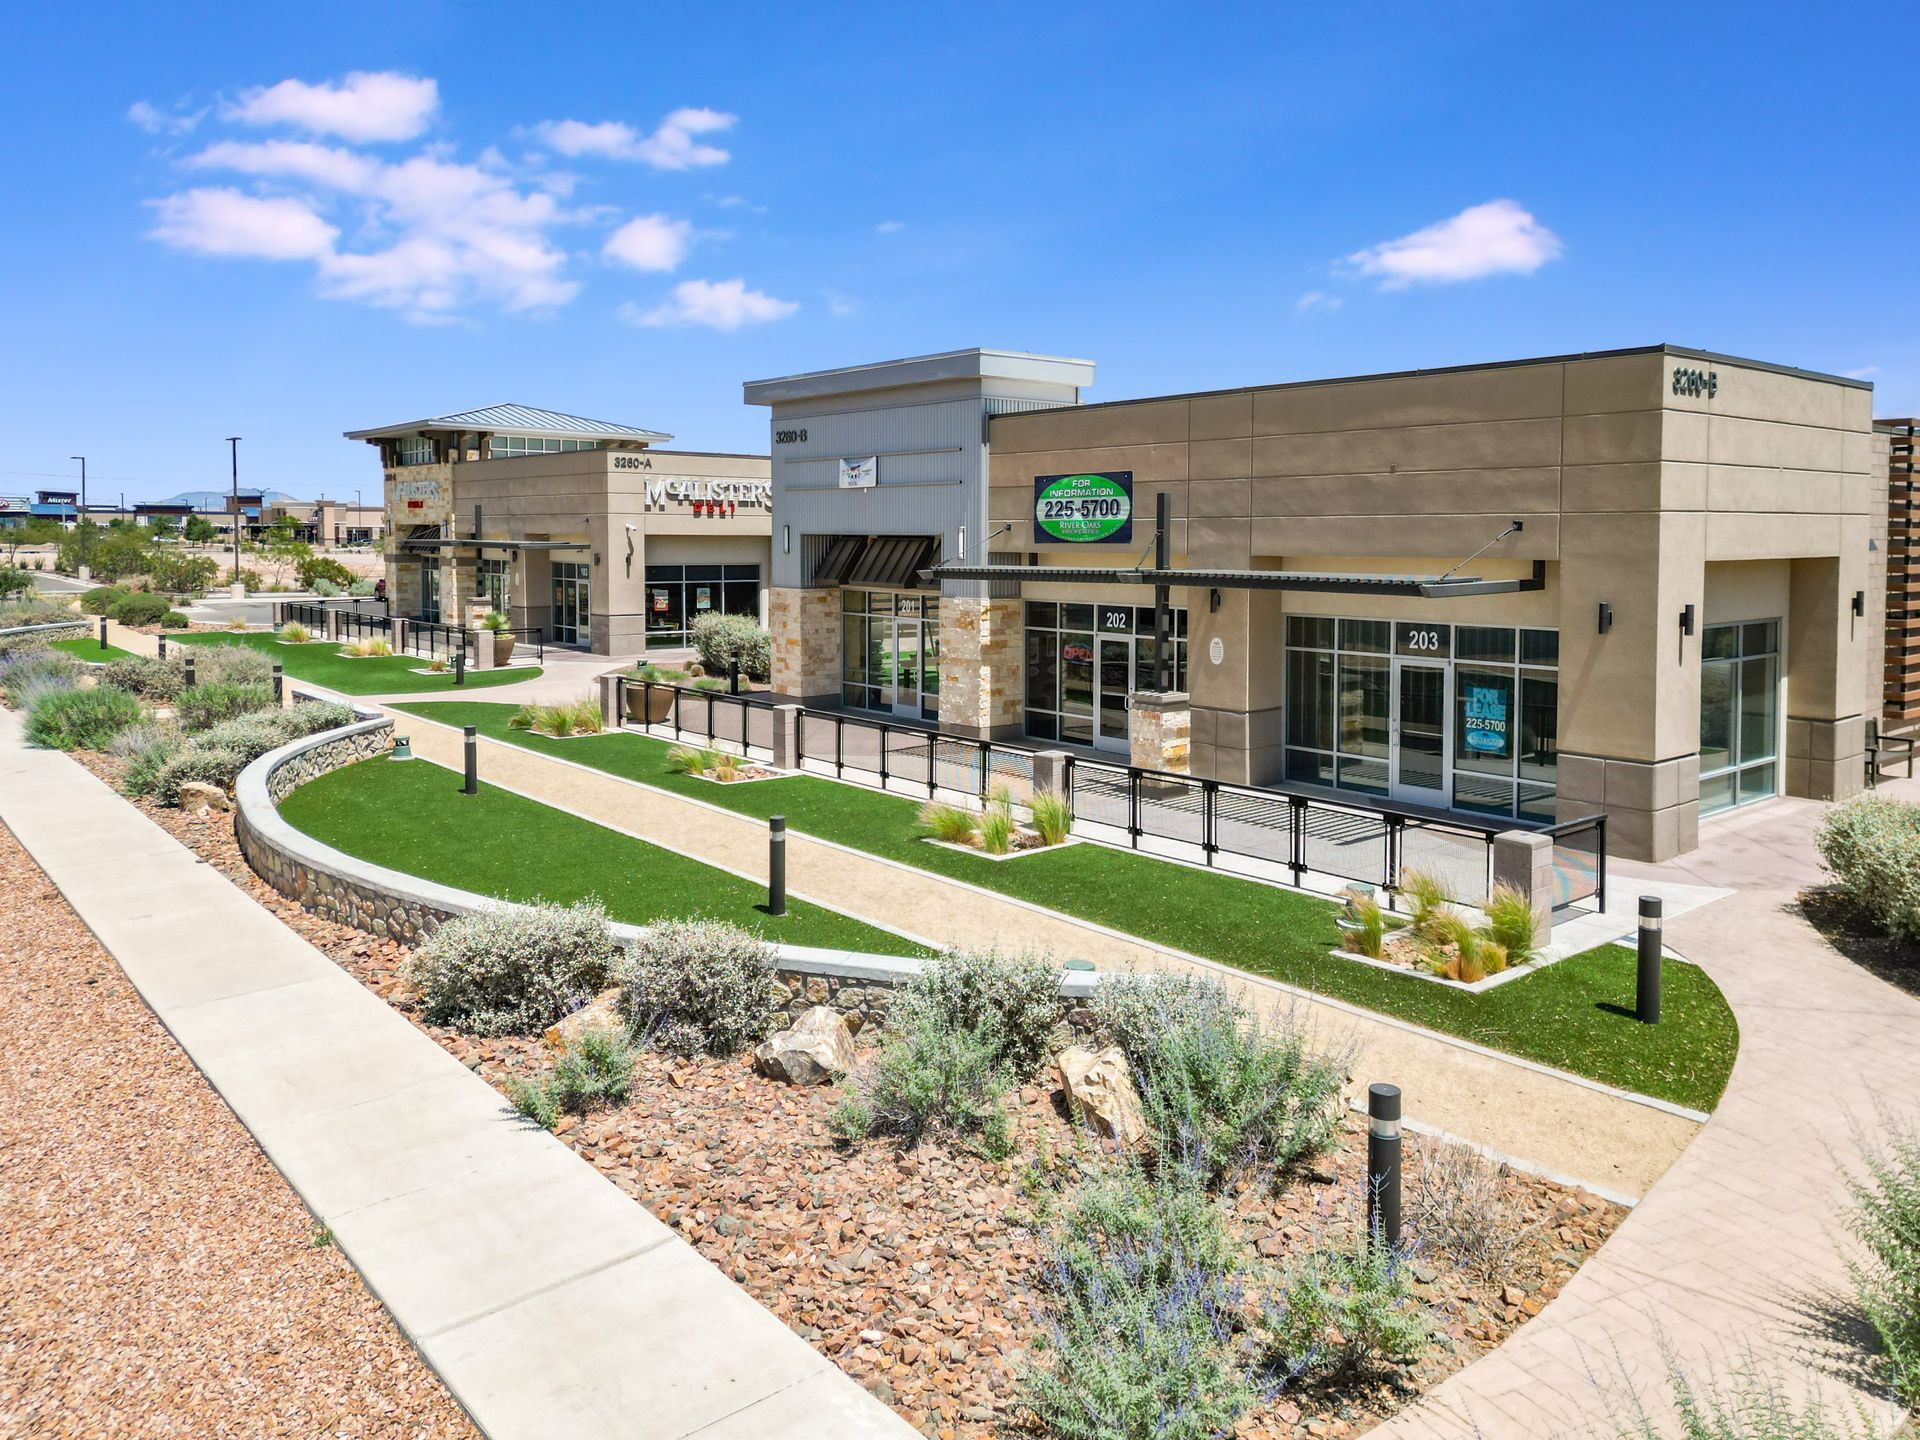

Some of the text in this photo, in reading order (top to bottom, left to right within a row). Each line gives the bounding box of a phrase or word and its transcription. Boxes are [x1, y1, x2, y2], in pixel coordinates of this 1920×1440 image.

[614, 457, 652, 470] 3260-A
[1072, 479, 1091, 487] FOR
[1049, 487, 1114, 497] INFORMATION
[693, 502, 736, 514] DELI
[1044, 499, 1121, 520] 225-5700
[1060, 520, 1101, 529] RIVER OAKS
[901, 599, 915, 614] 201
[1106, 612, 1127, 629] 202
[1408, 630, 1440, 651] 203
[1063, 644, 1094, 662] OPEN
[1472, 687, 1500, 706] FOR
[1465, 702, 1507, 721] LEASE
[1465, 717, 1507, 732] 225-5700
